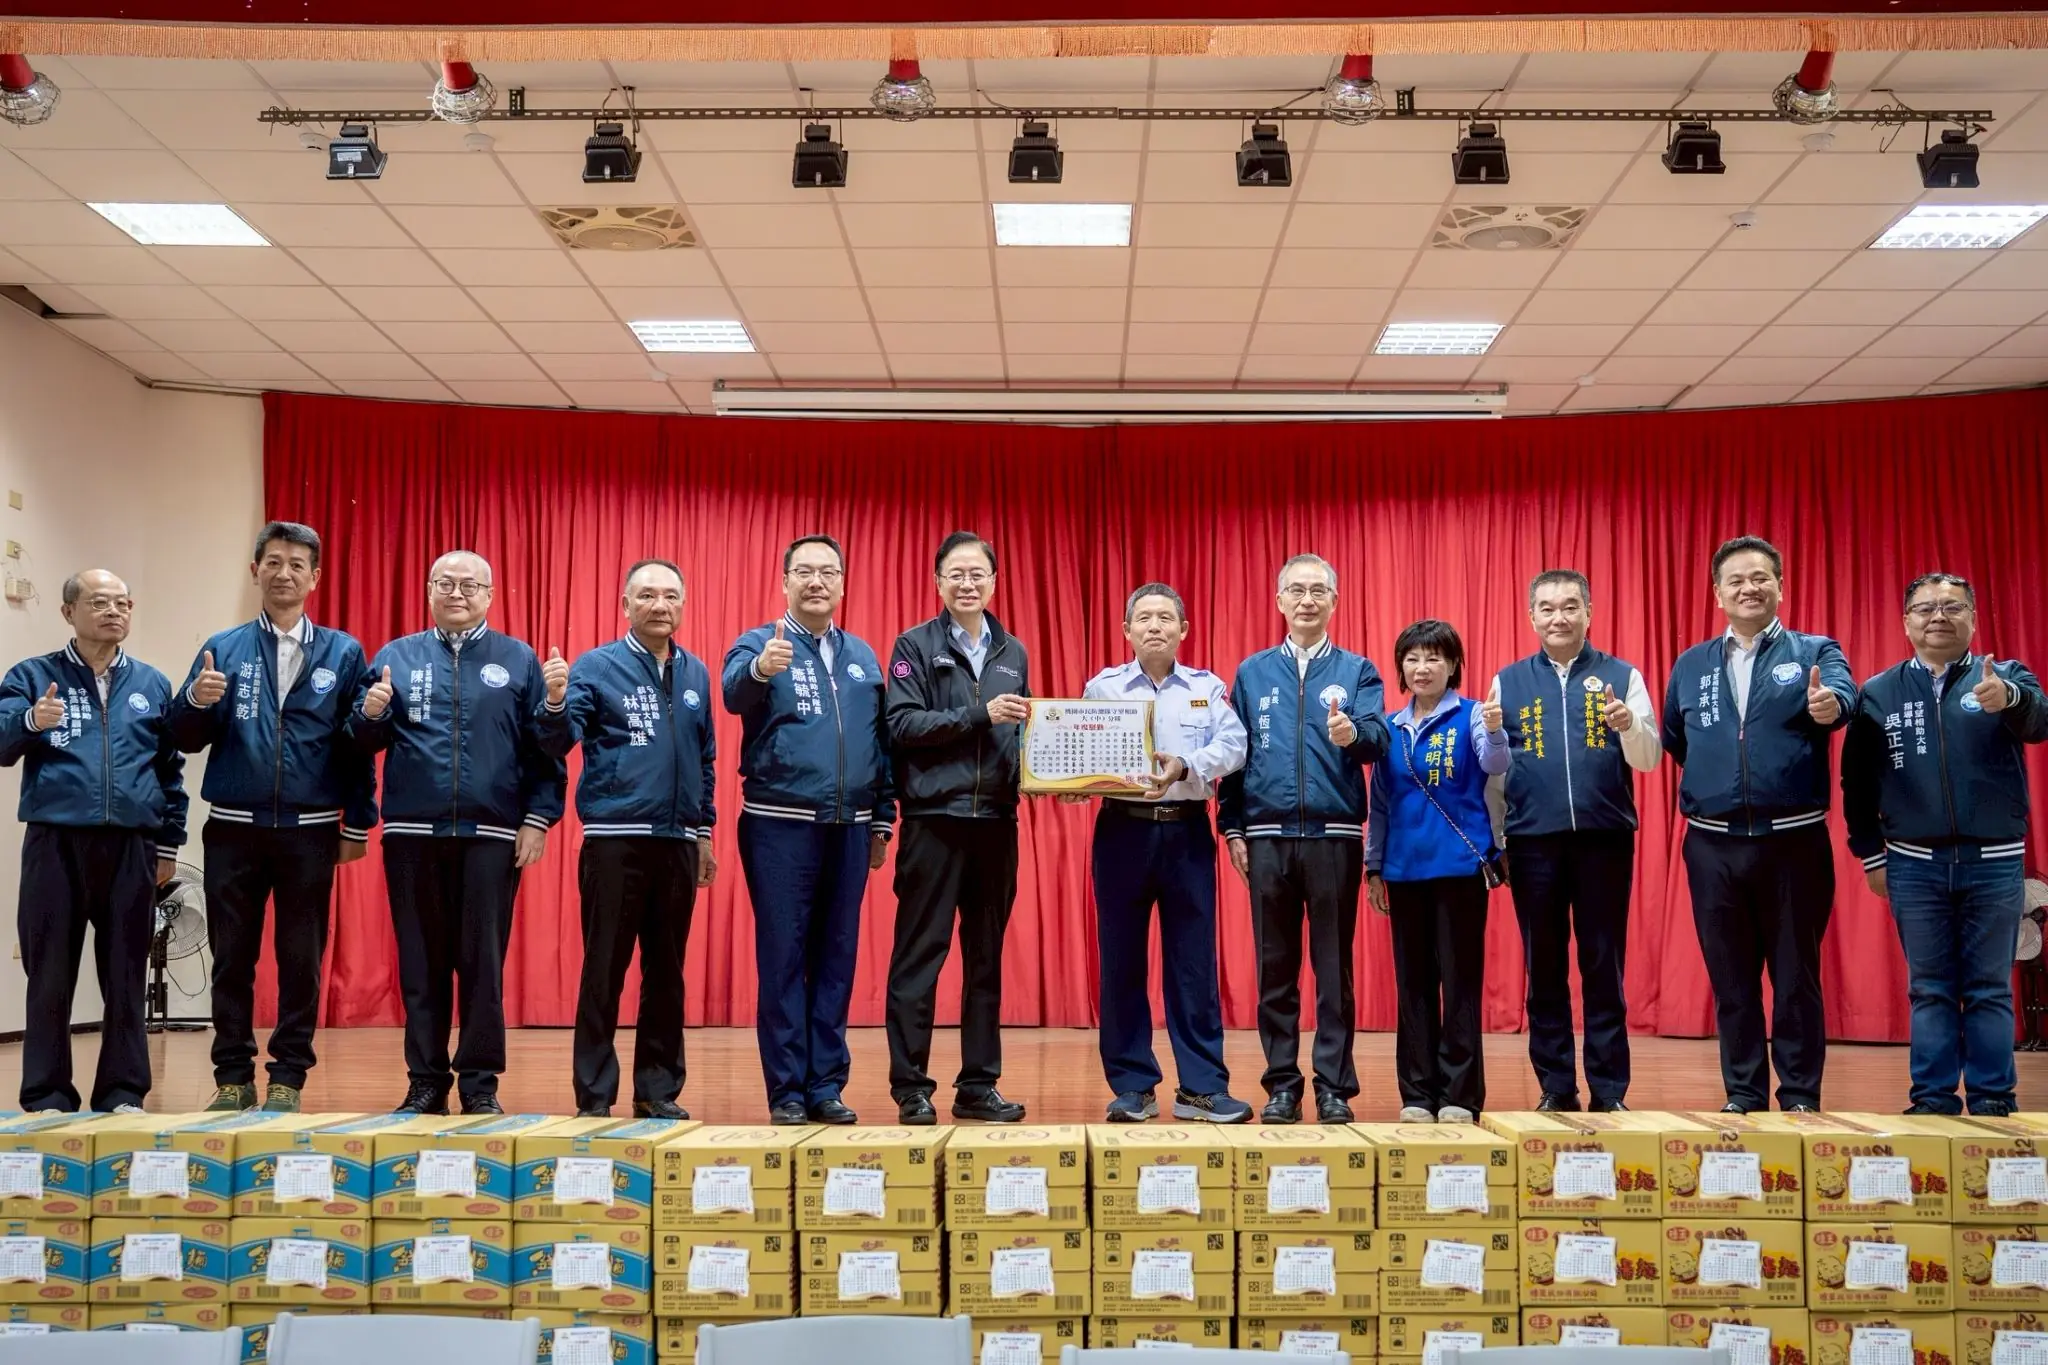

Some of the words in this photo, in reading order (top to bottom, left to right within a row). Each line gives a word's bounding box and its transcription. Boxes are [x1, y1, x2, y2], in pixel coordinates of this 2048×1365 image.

[78, 688, 92, 720] 守望相助
[236, 661, 253, 720] 游志乾
[408, 669, 424, 724] 陳基福
[647, 686, 660, 720] 守望相助
[804, 660, 823, 715] 守望相助大隊長
[1271, 687, 1279, 705] 局長
[1699, 675, 1713, 727] 郭承敬
[1903, 701, 1913, 728] 指導員
[622, 694, 648, 747] 林高雄
[1585, 692, 1597, 748] 守望相助大隊
[1596, 692, 1606, 749] 桃園市政府
[1884, 713, 1905, 770] 吳正吉
[1914, 700, 1927, 755] 守望相助大隊
[1425, 733, 1445, 787] 葉明月
[1444, 727, 1458, 780] 桃園市議員
